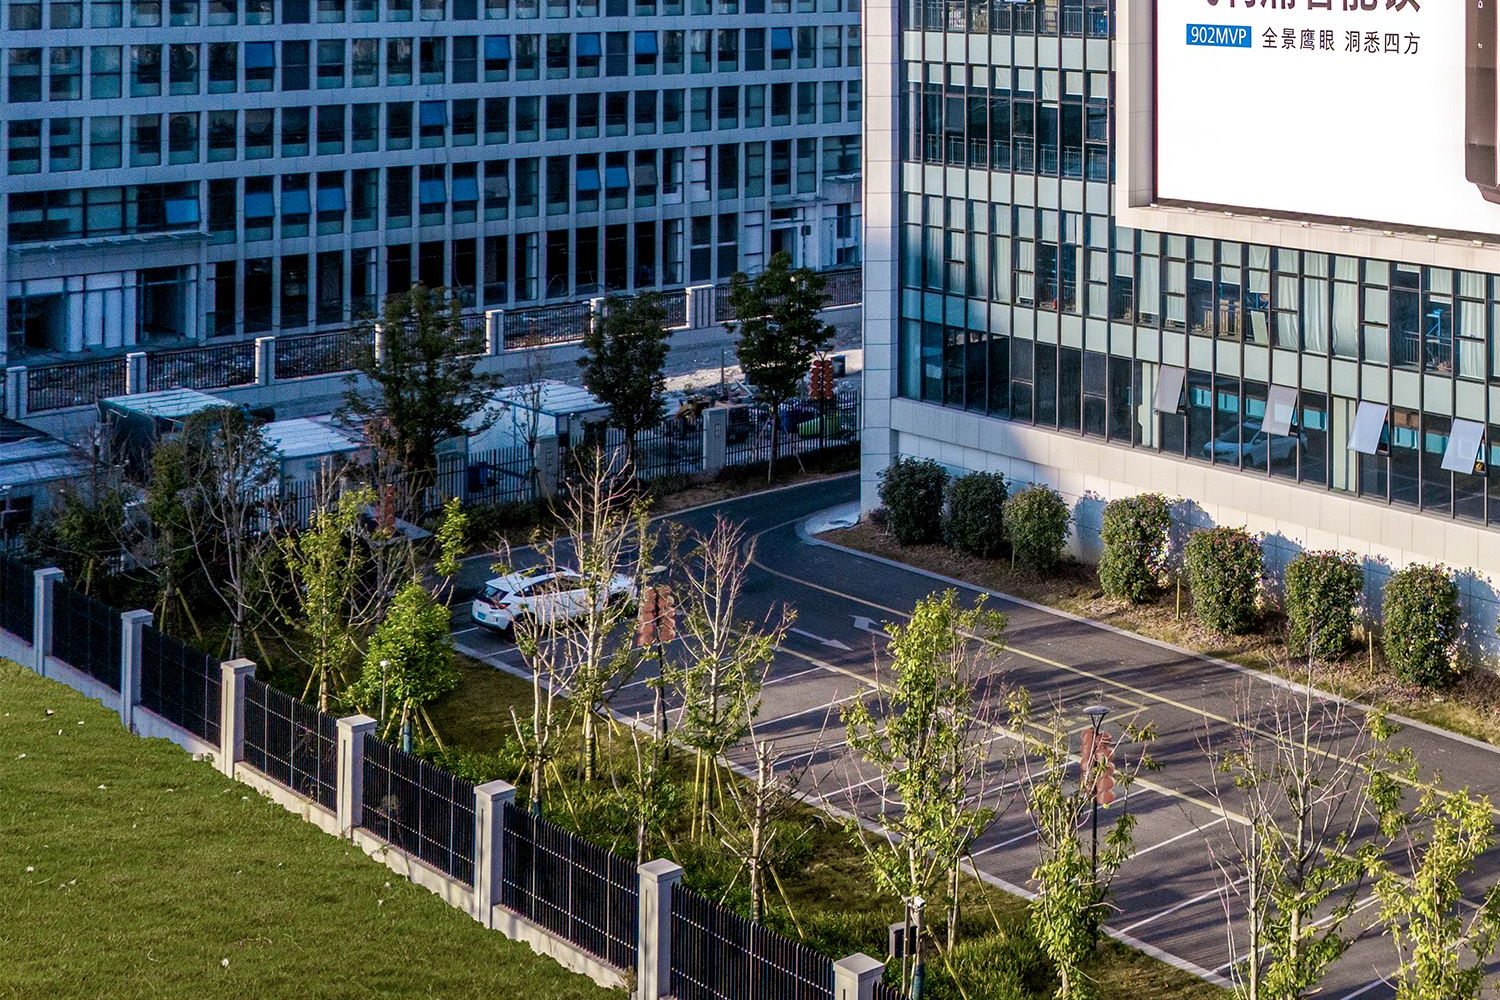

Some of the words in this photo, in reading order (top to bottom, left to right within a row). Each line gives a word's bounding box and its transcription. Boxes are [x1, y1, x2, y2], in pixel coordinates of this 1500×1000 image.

[1190, 26, 1247, 46] 902MVP
[1262, 27, 1335, 51] 全景鹰眼
[1345, 30, 1421, 55] 洞悉四方
